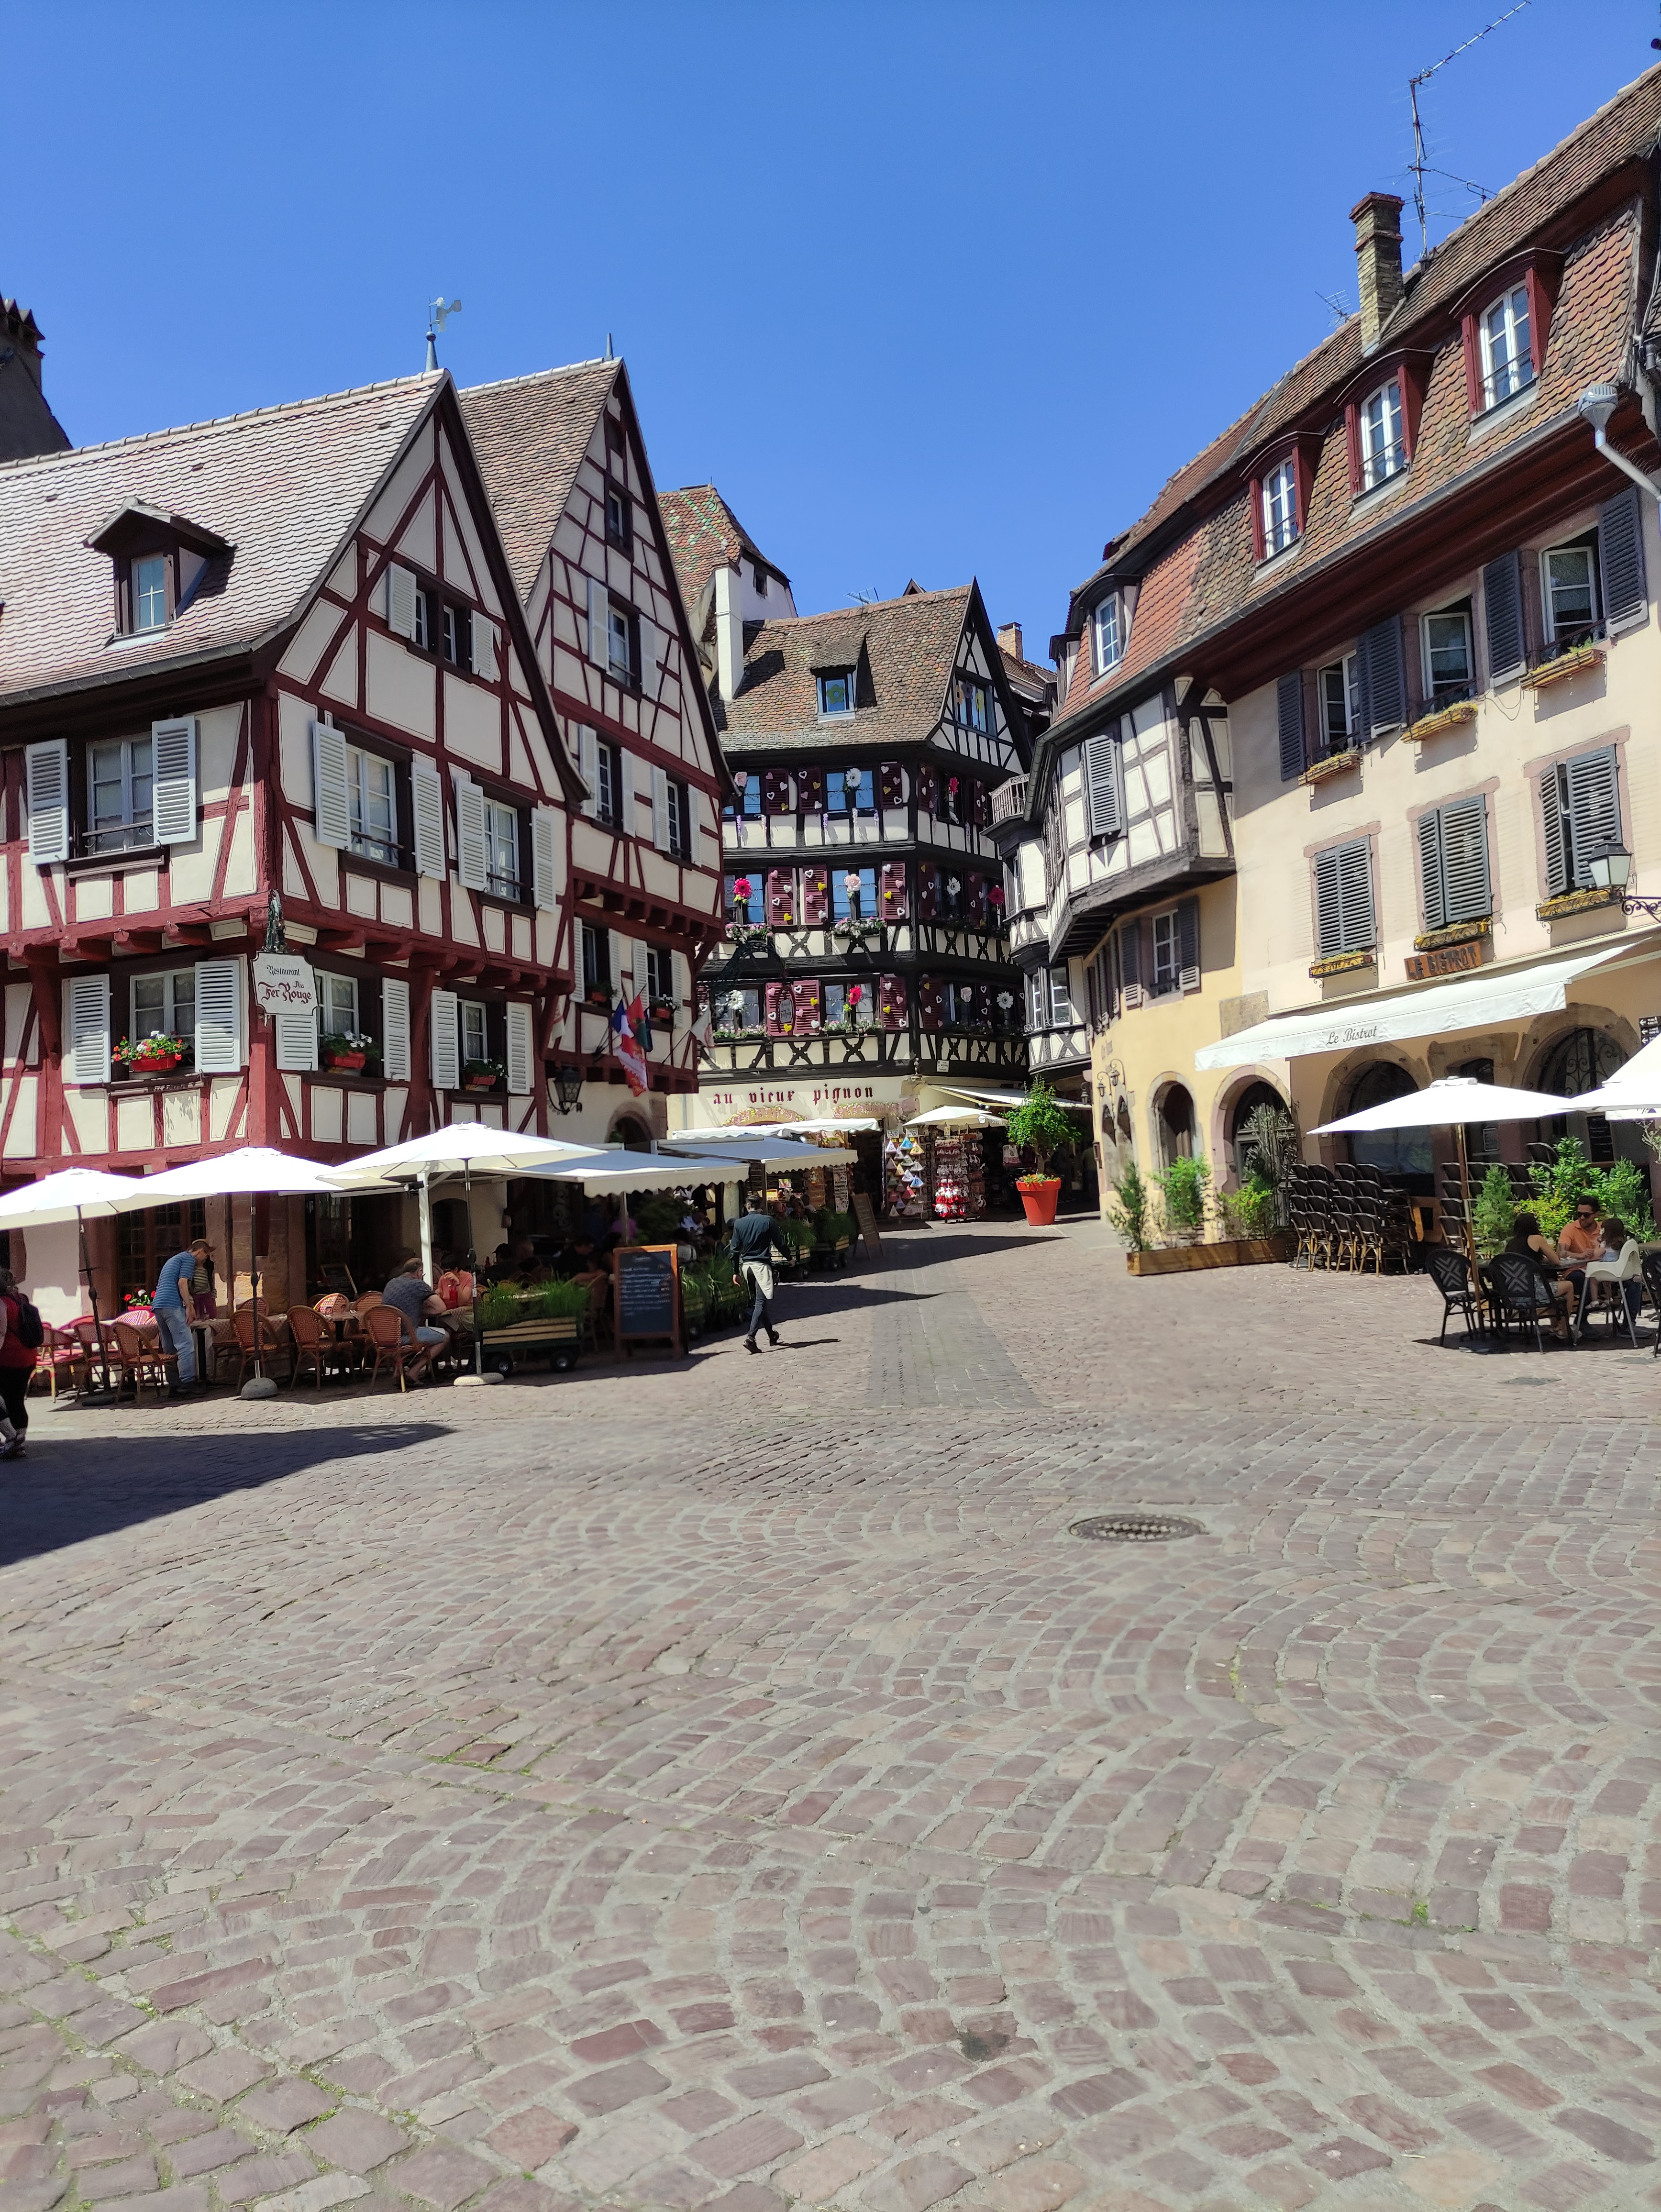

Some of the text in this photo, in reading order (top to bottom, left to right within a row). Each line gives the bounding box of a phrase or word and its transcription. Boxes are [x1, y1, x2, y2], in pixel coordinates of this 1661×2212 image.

[266, 965, 300, 976] Restaurant
[1407, 959, 1424, 978] LE
[257, 981, 312, 1004] Fer Rouge
[1326, 1025, 1377, 1045] Le Bistrot
[713, 1083, 873, 1106] au vieux pignon
